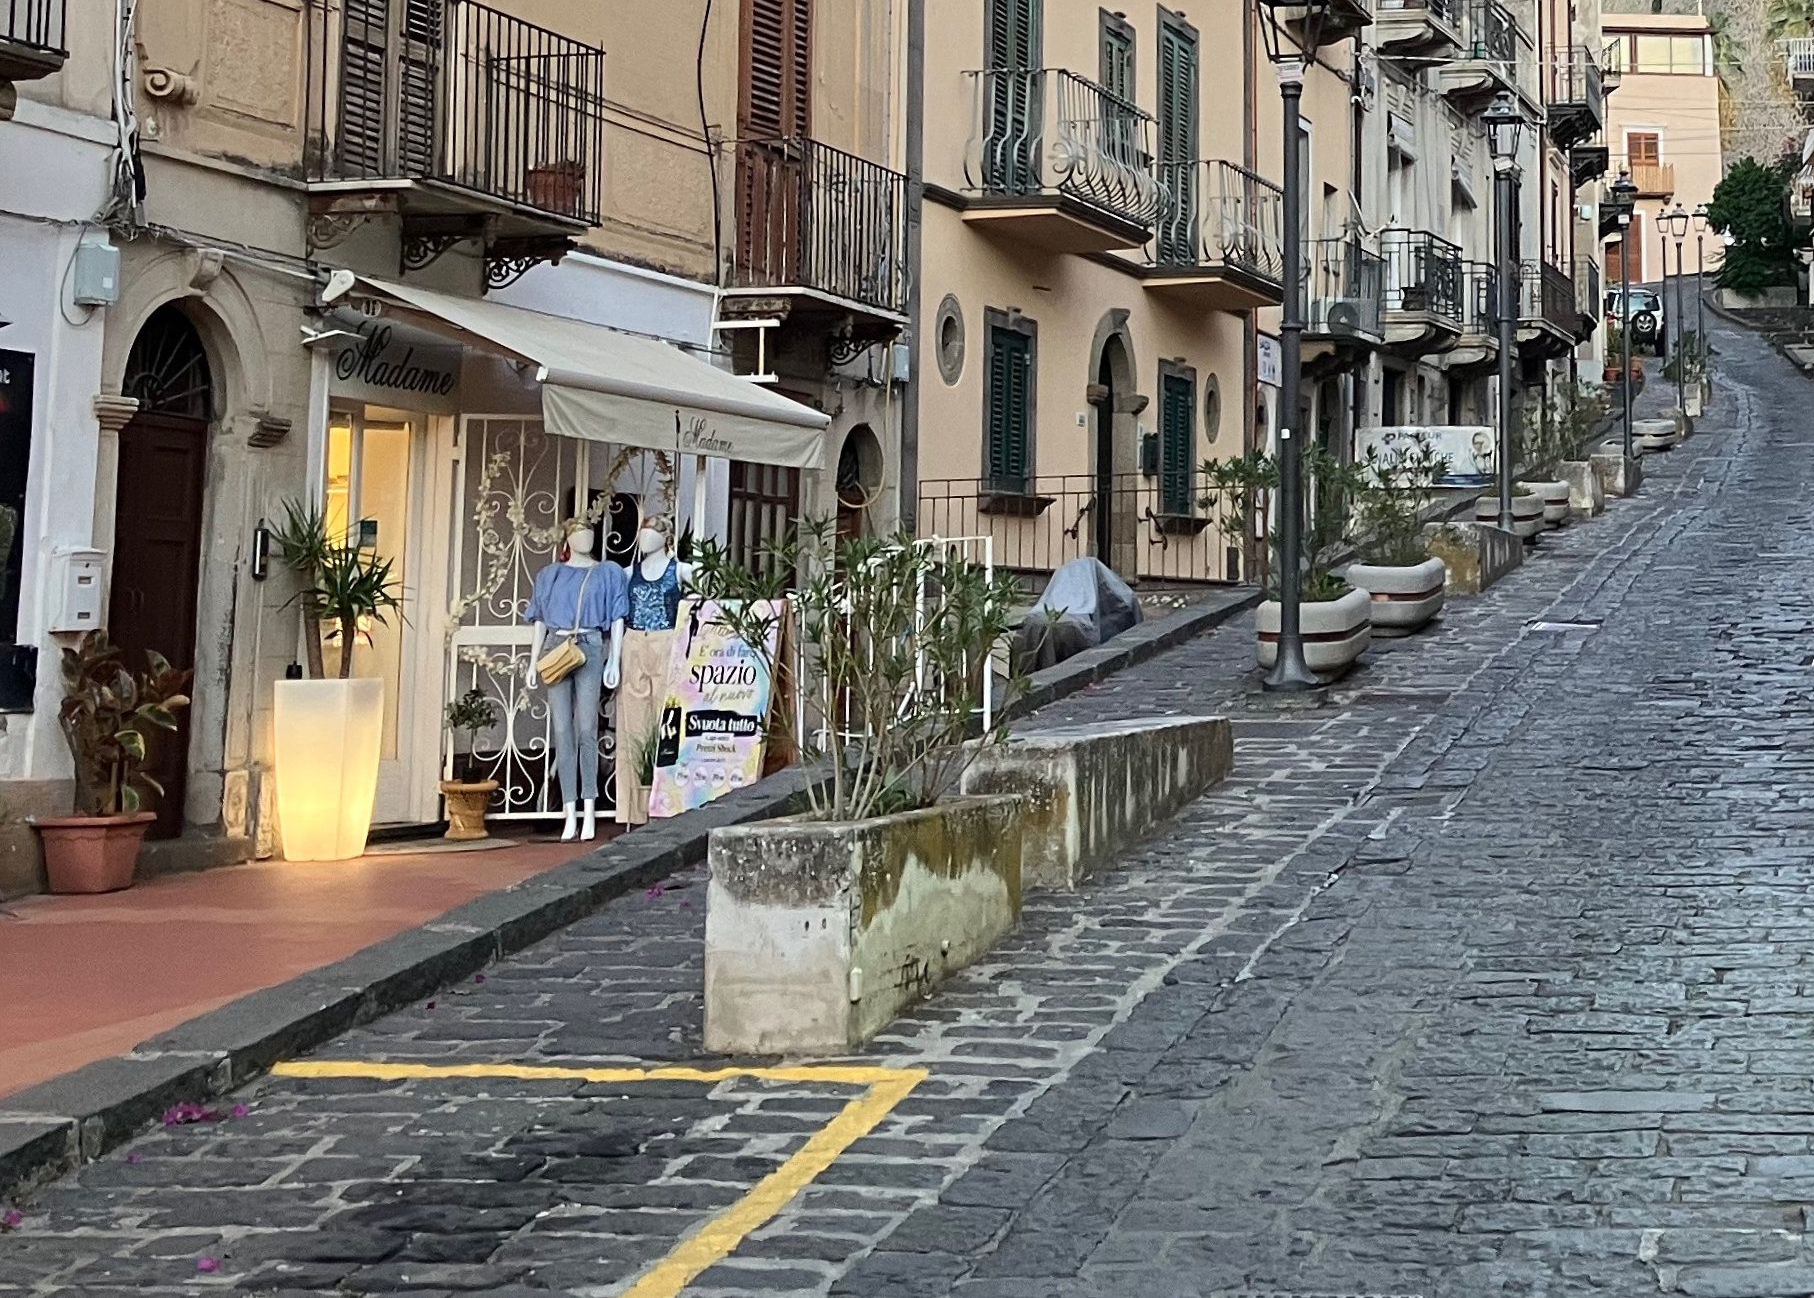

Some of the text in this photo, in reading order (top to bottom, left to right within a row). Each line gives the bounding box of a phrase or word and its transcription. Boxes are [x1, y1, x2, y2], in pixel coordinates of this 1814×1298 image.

[336, 320, 455, 396] Madame
[683, 415, 735, 455] Madame
[726, 645, 736, 658] di
[690, 659, 757, 692] spazio
[688, 714, 755, 732] Svuota tutto
